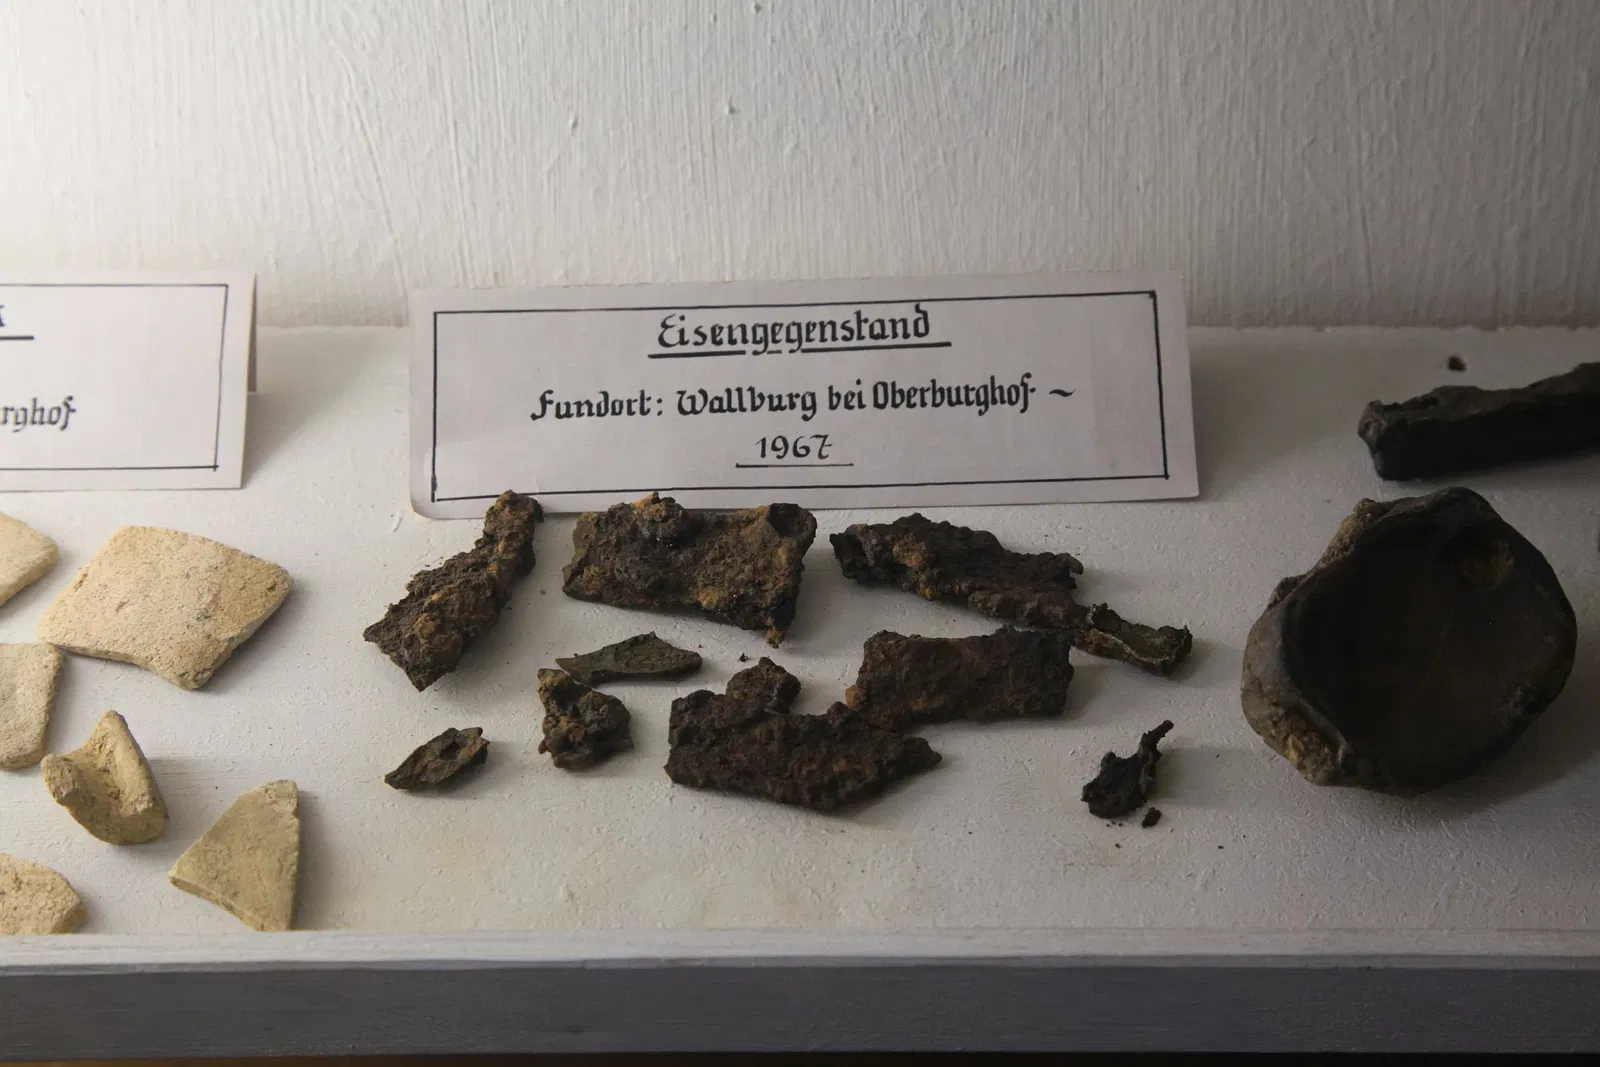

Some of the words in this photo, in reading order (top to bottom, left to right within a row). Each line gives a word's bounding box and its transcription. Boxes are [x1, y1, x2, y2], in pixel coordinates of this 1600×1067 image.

[657, 303, 931, 356] Eisengegenstand
[530, 389, 664, 421] Fundort:
[676, 385, 818, 422] Wallburg
[829, 378, 867, 411] bei
[872, 371, 1037, 417] Oberburghof
[755, 433, 833, 460] 1967
